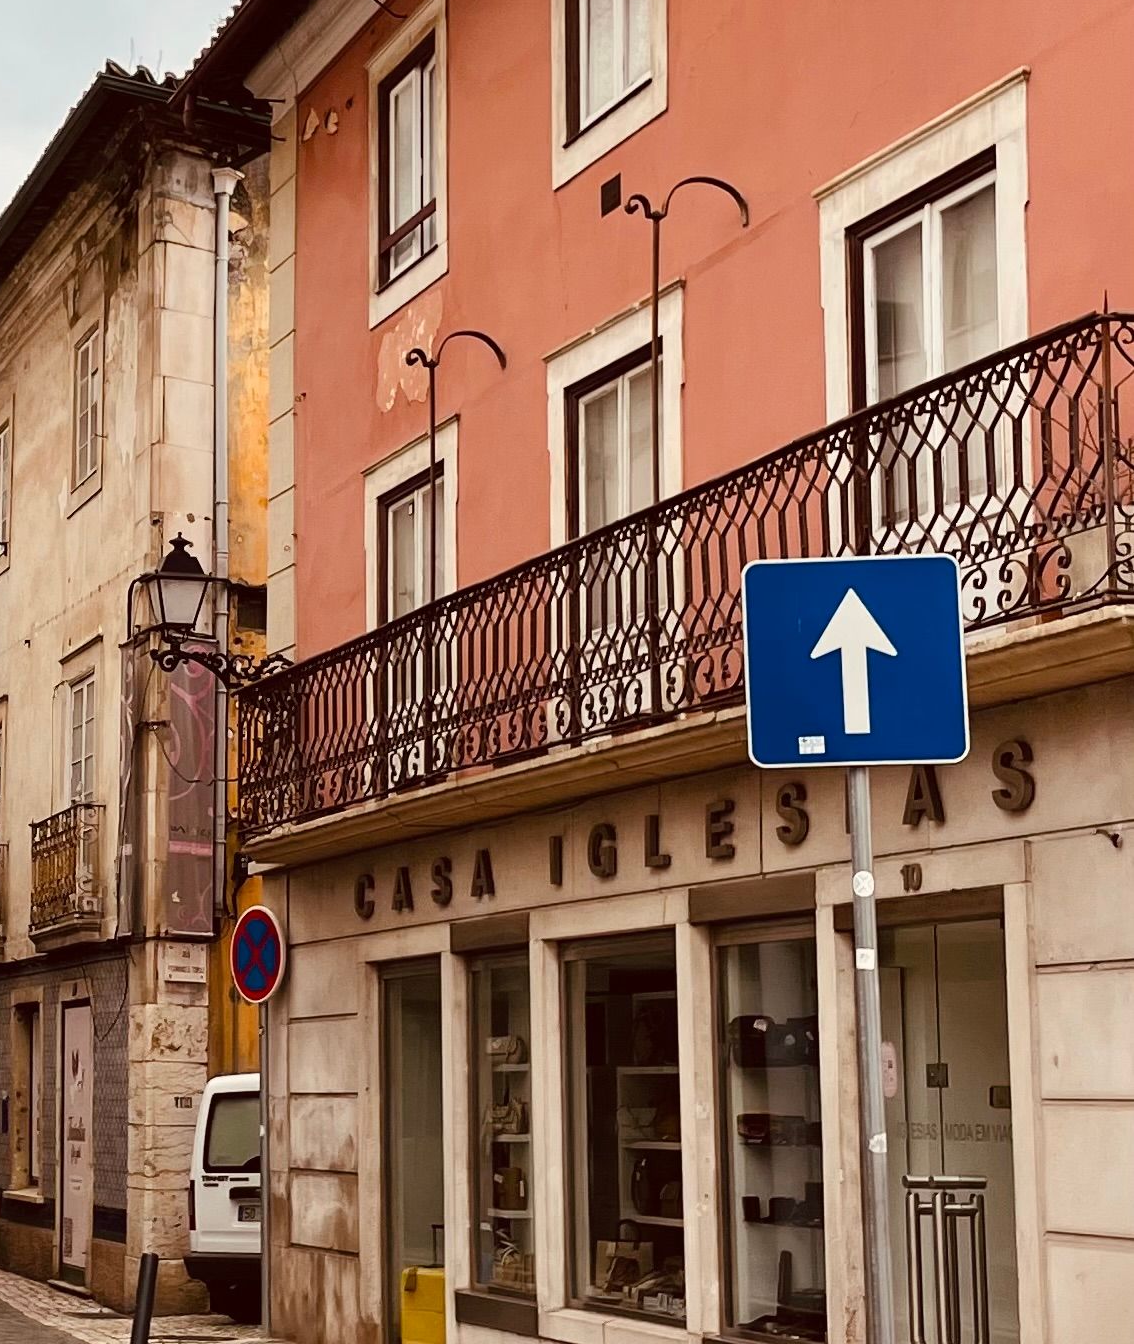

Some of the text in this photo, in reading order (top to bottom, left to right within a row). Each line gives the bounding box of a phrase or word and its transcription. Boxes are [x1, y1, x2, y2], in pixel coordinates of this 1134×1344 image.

[353, 847, 496, 920] CASA
[900, 863, 923, 893] 10
[944, 1122, 974, 1142] MODA
[975, 1122, 990, 1143] EM
